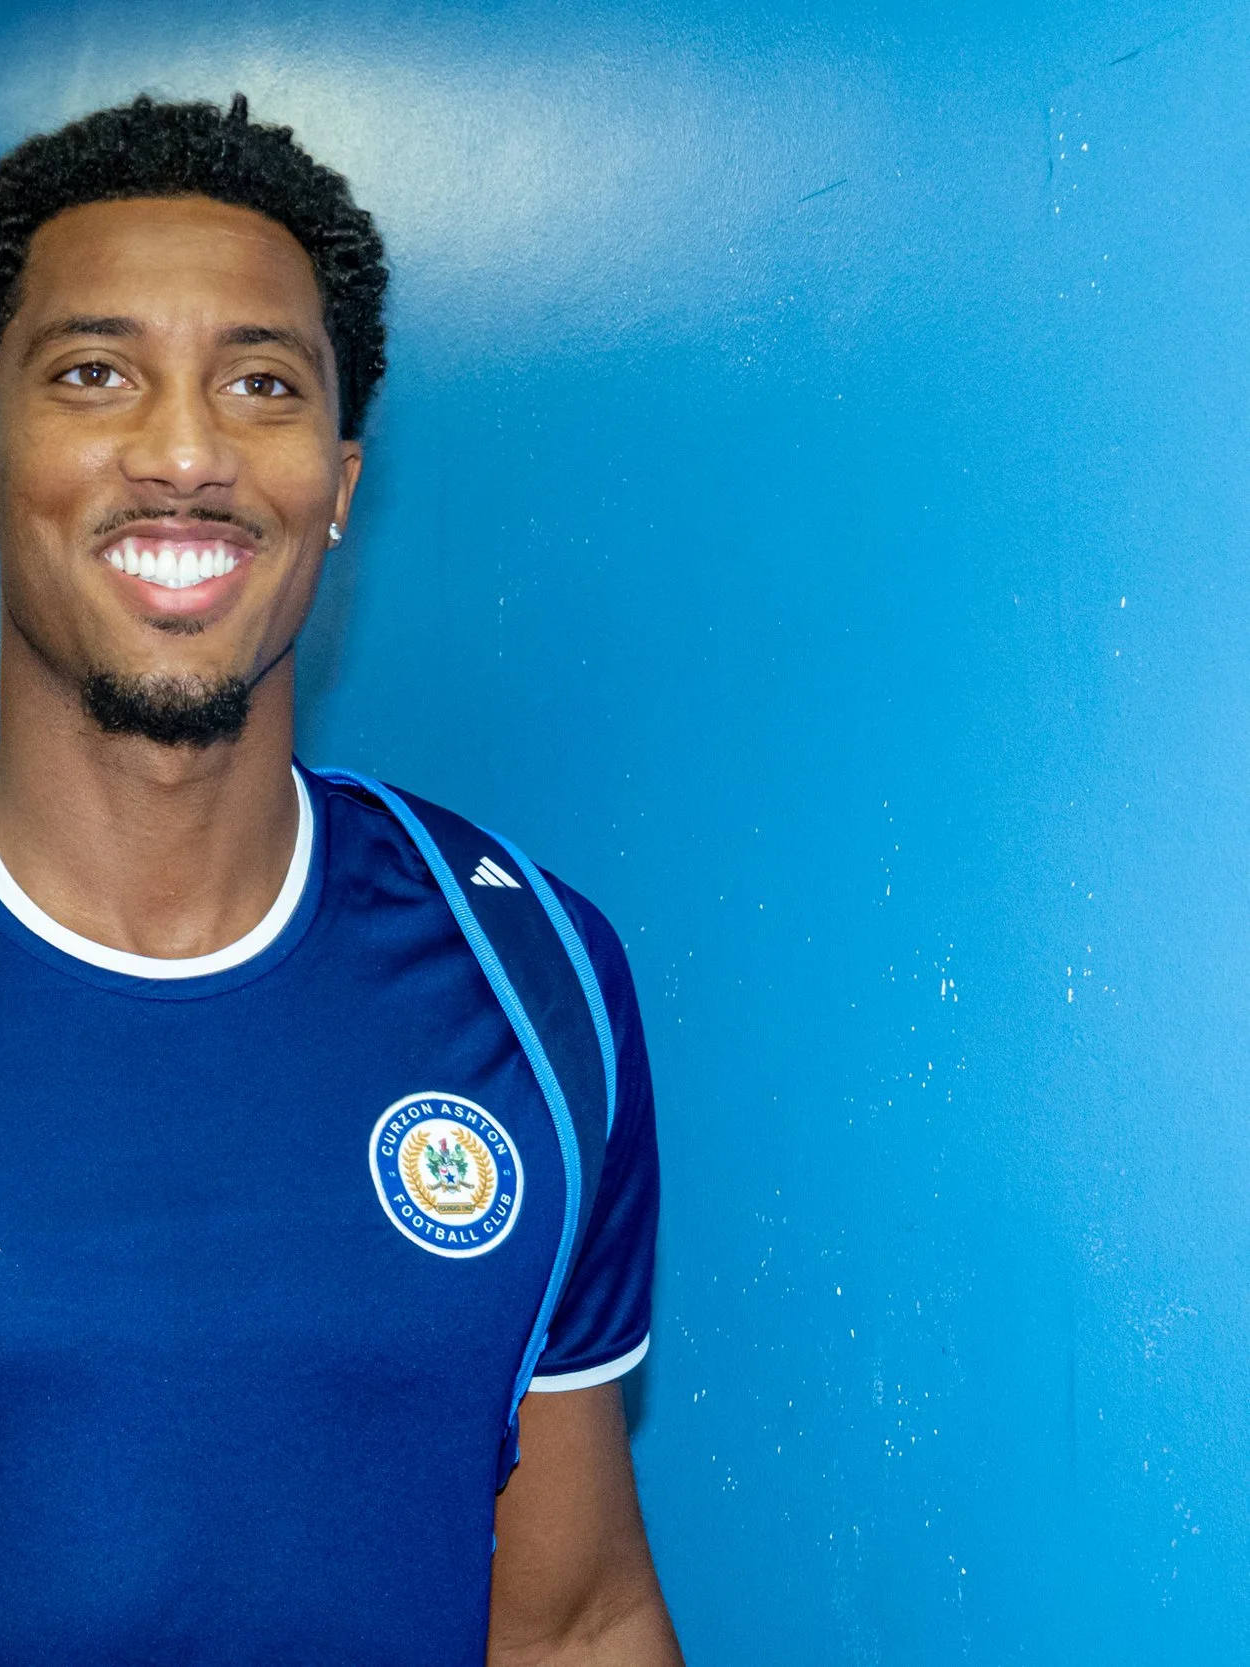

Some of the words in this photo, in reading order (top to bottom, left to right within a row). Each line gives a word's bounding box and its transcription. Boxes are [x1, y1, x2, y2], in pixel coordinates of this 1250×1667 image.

[382, 1103, 433, 1157] CURZON
[441, 1103, 508, 1155] ASHTON
[393, 1193, 479, 1243] FOOTBALL
[483, 1194, 512, 1233] CLUB
